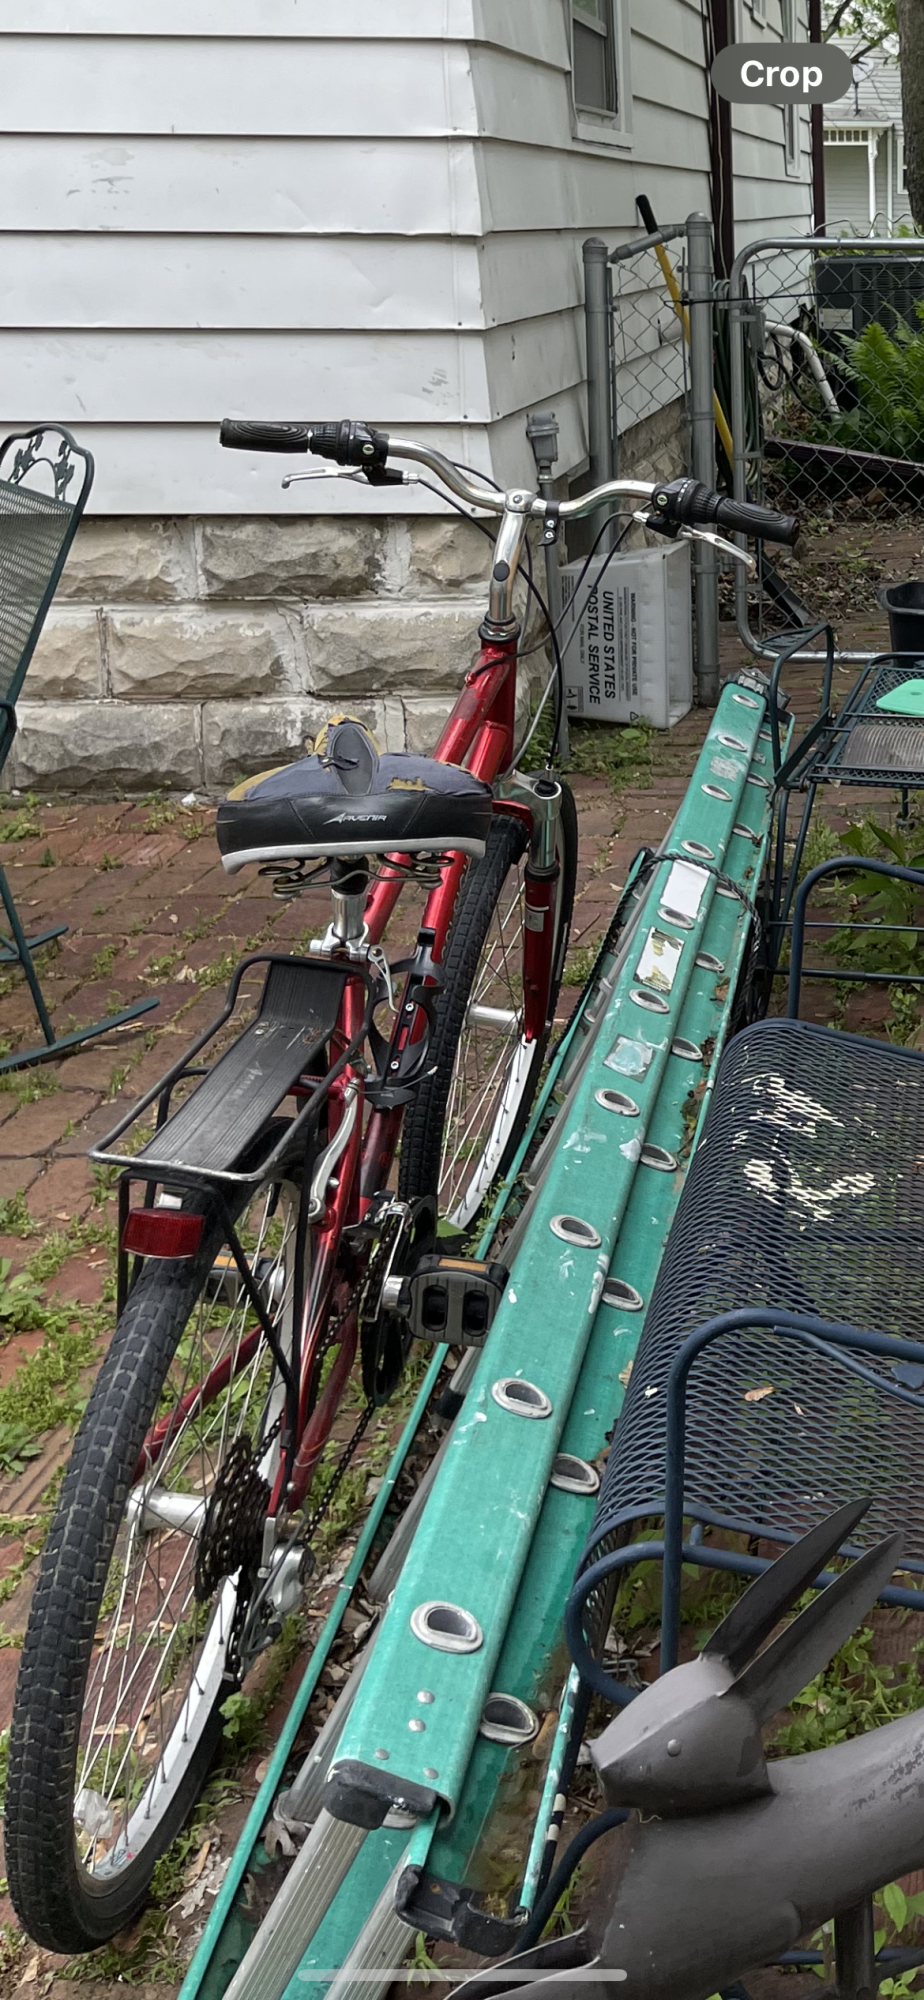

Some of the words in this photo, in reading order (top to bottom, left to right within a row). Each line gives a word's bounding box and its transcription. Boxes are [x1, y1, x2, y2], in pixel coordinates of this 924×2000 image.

[587, 584, 600, 640] POSTAL
[602, 590, 615, 642] UNITED
[588, 643, 600, 705] SERVICE
[603, 645, 616, 699] STATES
